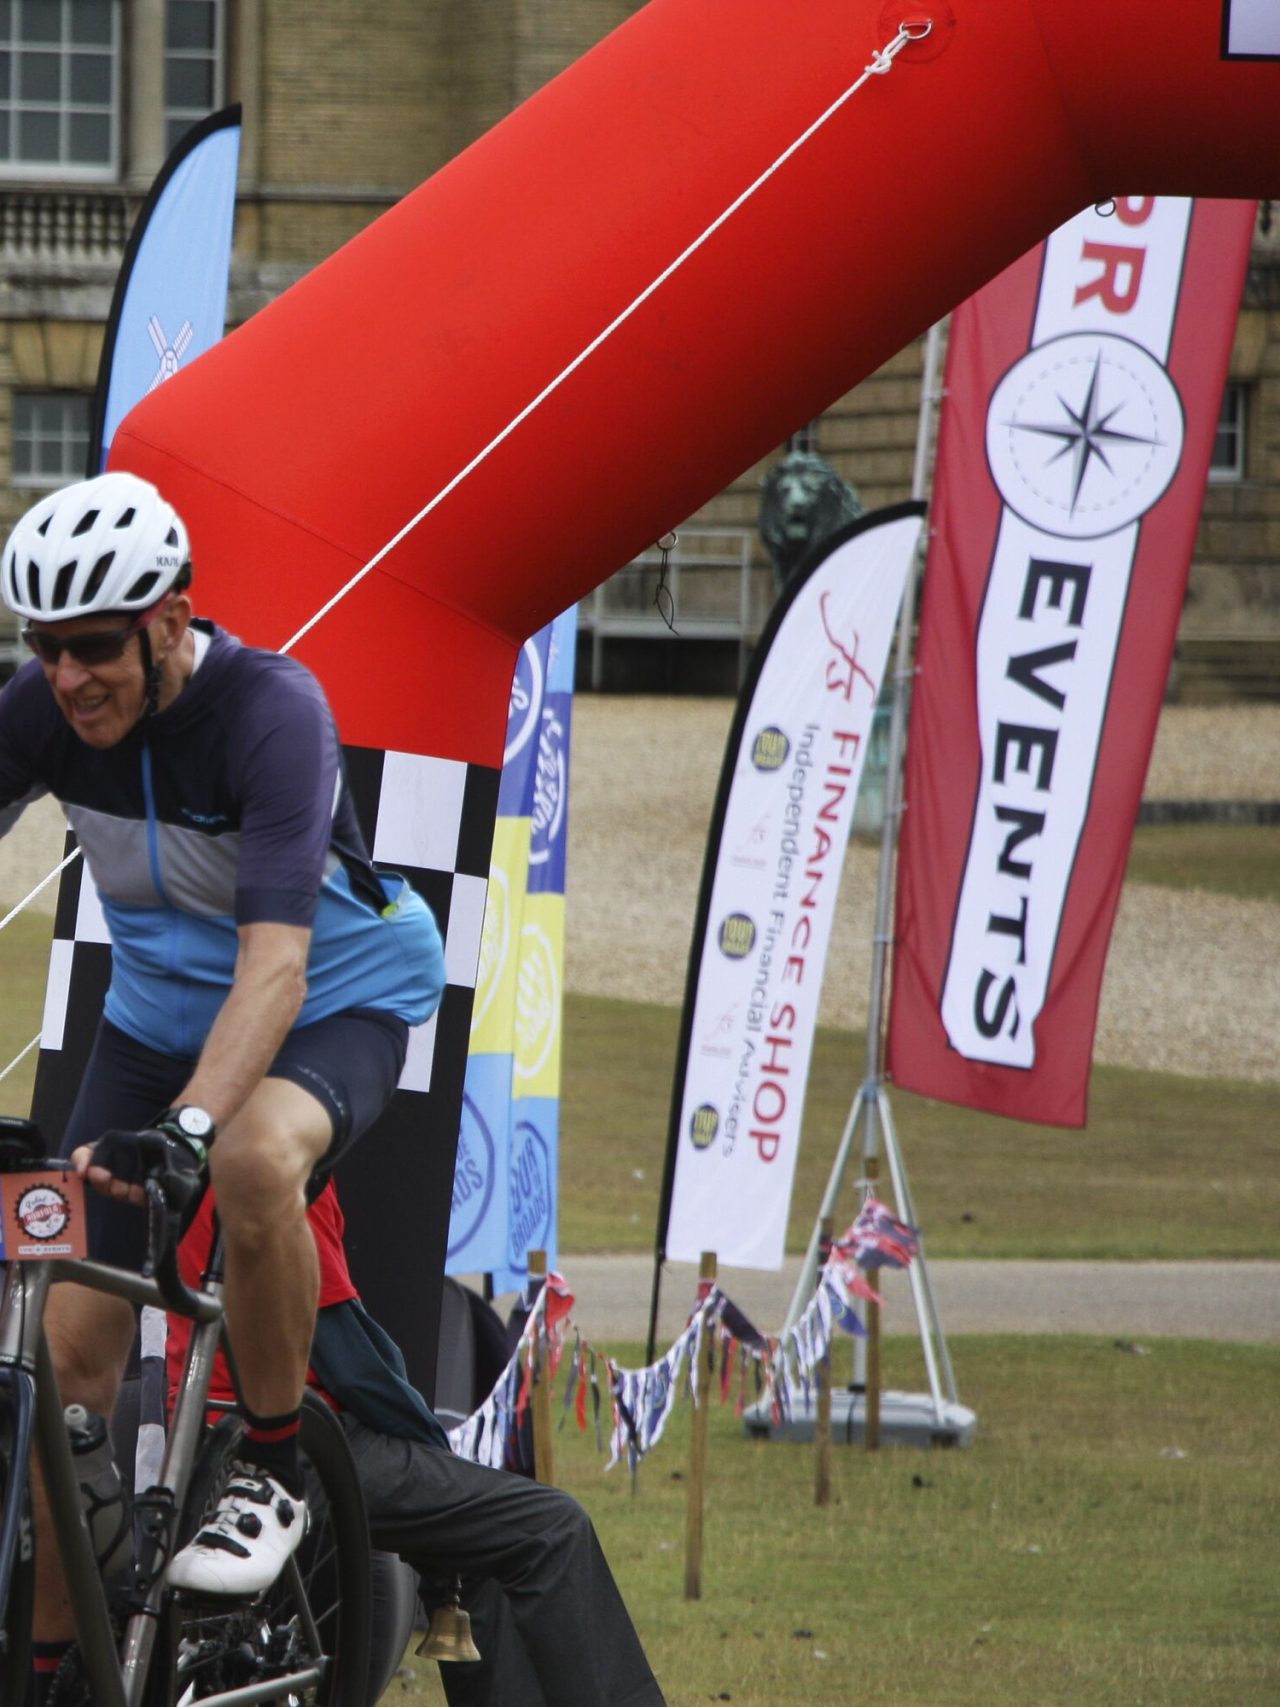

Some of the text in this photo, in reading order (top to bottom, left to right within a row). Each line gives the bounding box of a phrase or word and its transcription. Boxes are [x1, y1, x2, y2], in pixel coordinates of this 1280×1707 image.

[748, 731, 861, 1164] FINANCE SHOP
[772, 723, 821, 900] Independent
[973, 555, 1094, 1042] EVENTS
[746, 909, 786, 1033] Financial
